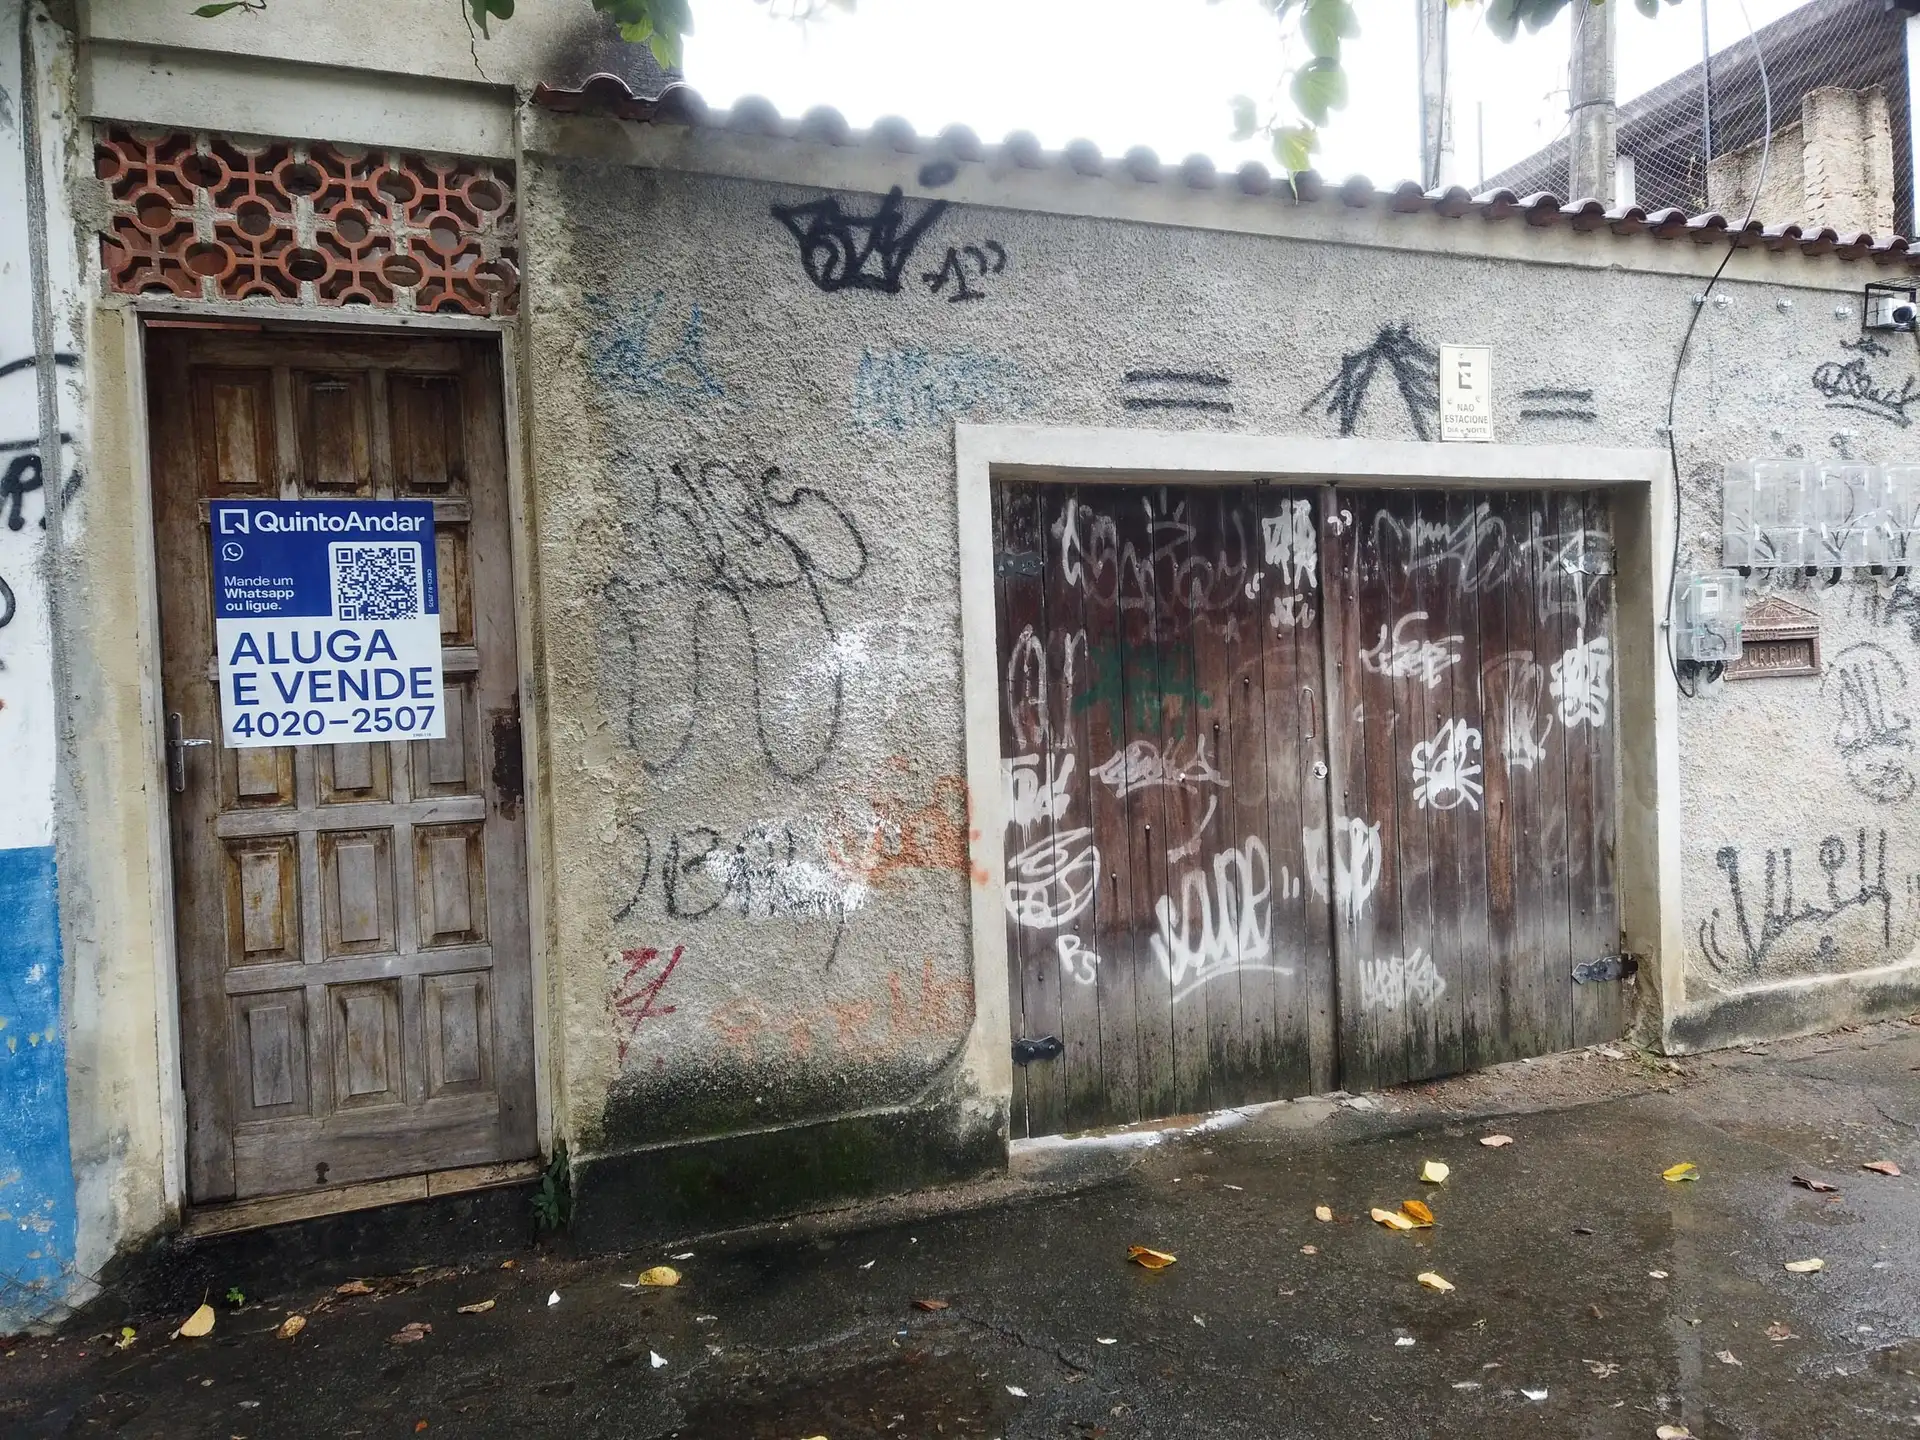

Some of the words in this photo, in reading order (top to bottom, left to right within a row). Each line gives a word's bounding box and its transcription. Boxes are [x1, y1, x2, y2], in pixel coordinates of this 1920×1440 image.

[1444, 415, 1489, 424] ESTACIONE
[254, 510, 425, 533] QuintoAndar
[224, 576, 270, 587] Mande
[272, 577, 294, 586] um
[224, 588, 295, 600] Whatsapp
[225, 602, 243, 611] ou
[245, 600, 282, 613] ligue.
[229, 629, 398, 666] ALUGA
[232, 672, 260, 706] E
[271, 666, 435, 704] VENDE
[232, 705, 436, 738] 4020-2507
